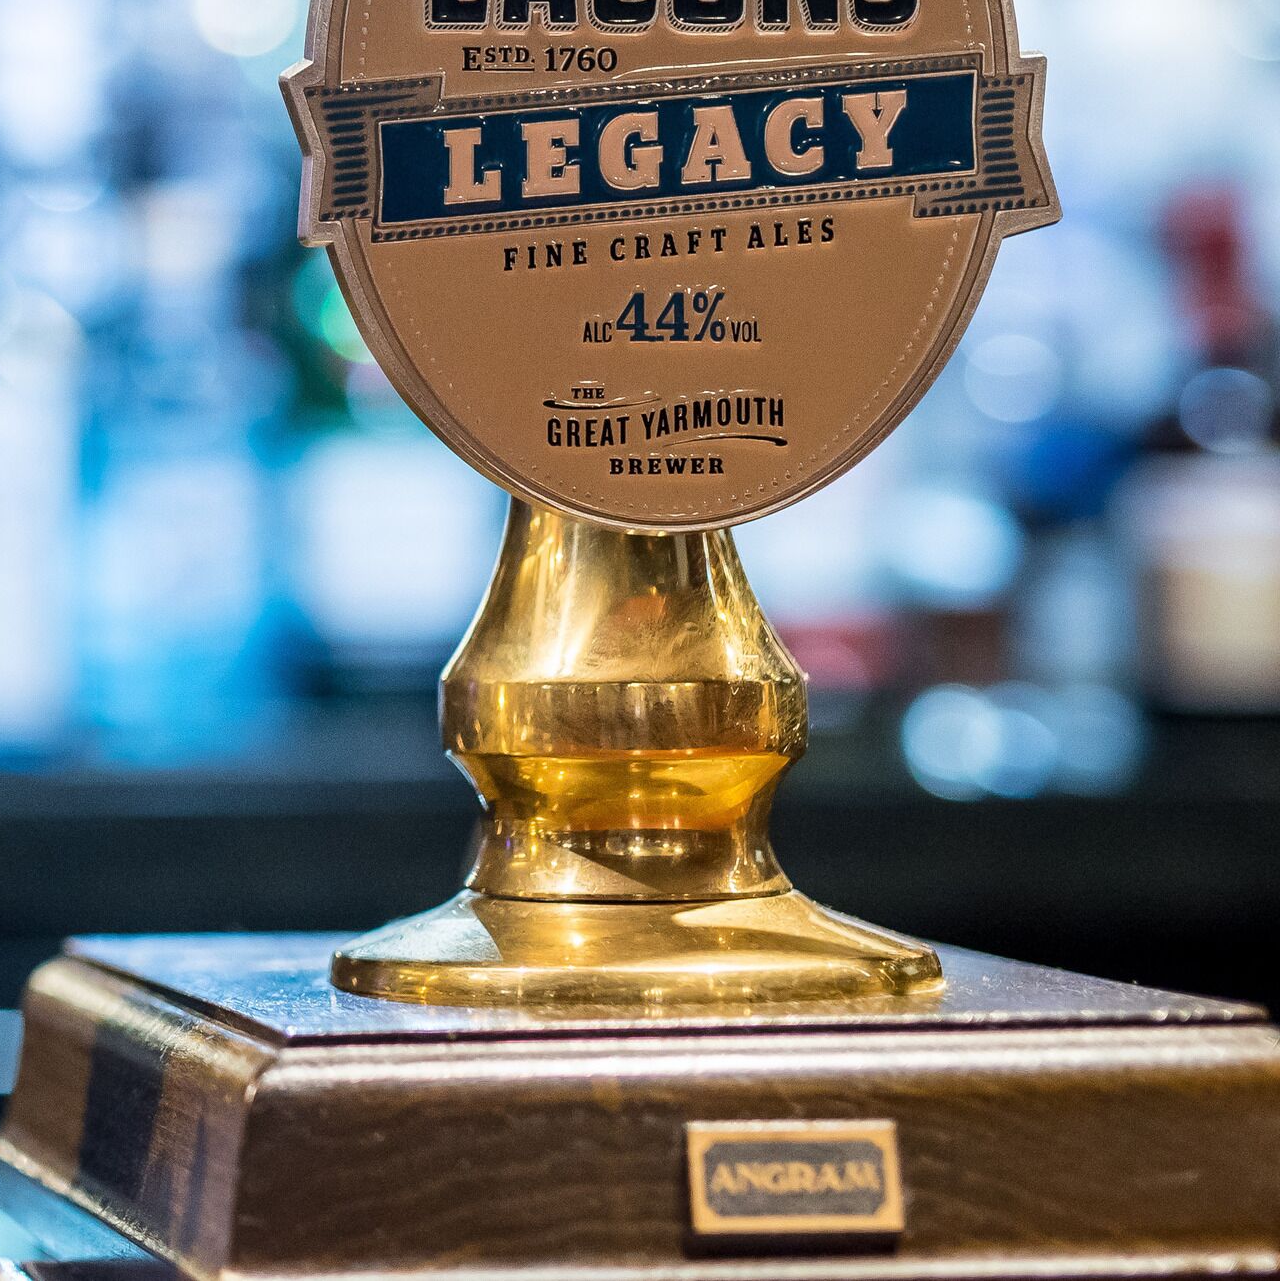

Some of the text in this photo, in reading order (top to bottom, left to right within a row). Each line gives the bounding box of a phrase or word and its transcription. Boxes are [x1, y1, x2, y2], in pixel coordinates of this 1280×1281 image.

[543, 46, 618, 72] 1760
[442, 91, 908, 206] LEGACY
[503, 218, 835, 271] FINE CRAFT ALES
[582, 321, 613, 343] ALC
[730, 320, 762, 343] VOL
[571, 386, 606, 399] THE
[546, 396, 785, 449] GREAT YARMOUTH
[609, 457, 725, 476] BREWER
